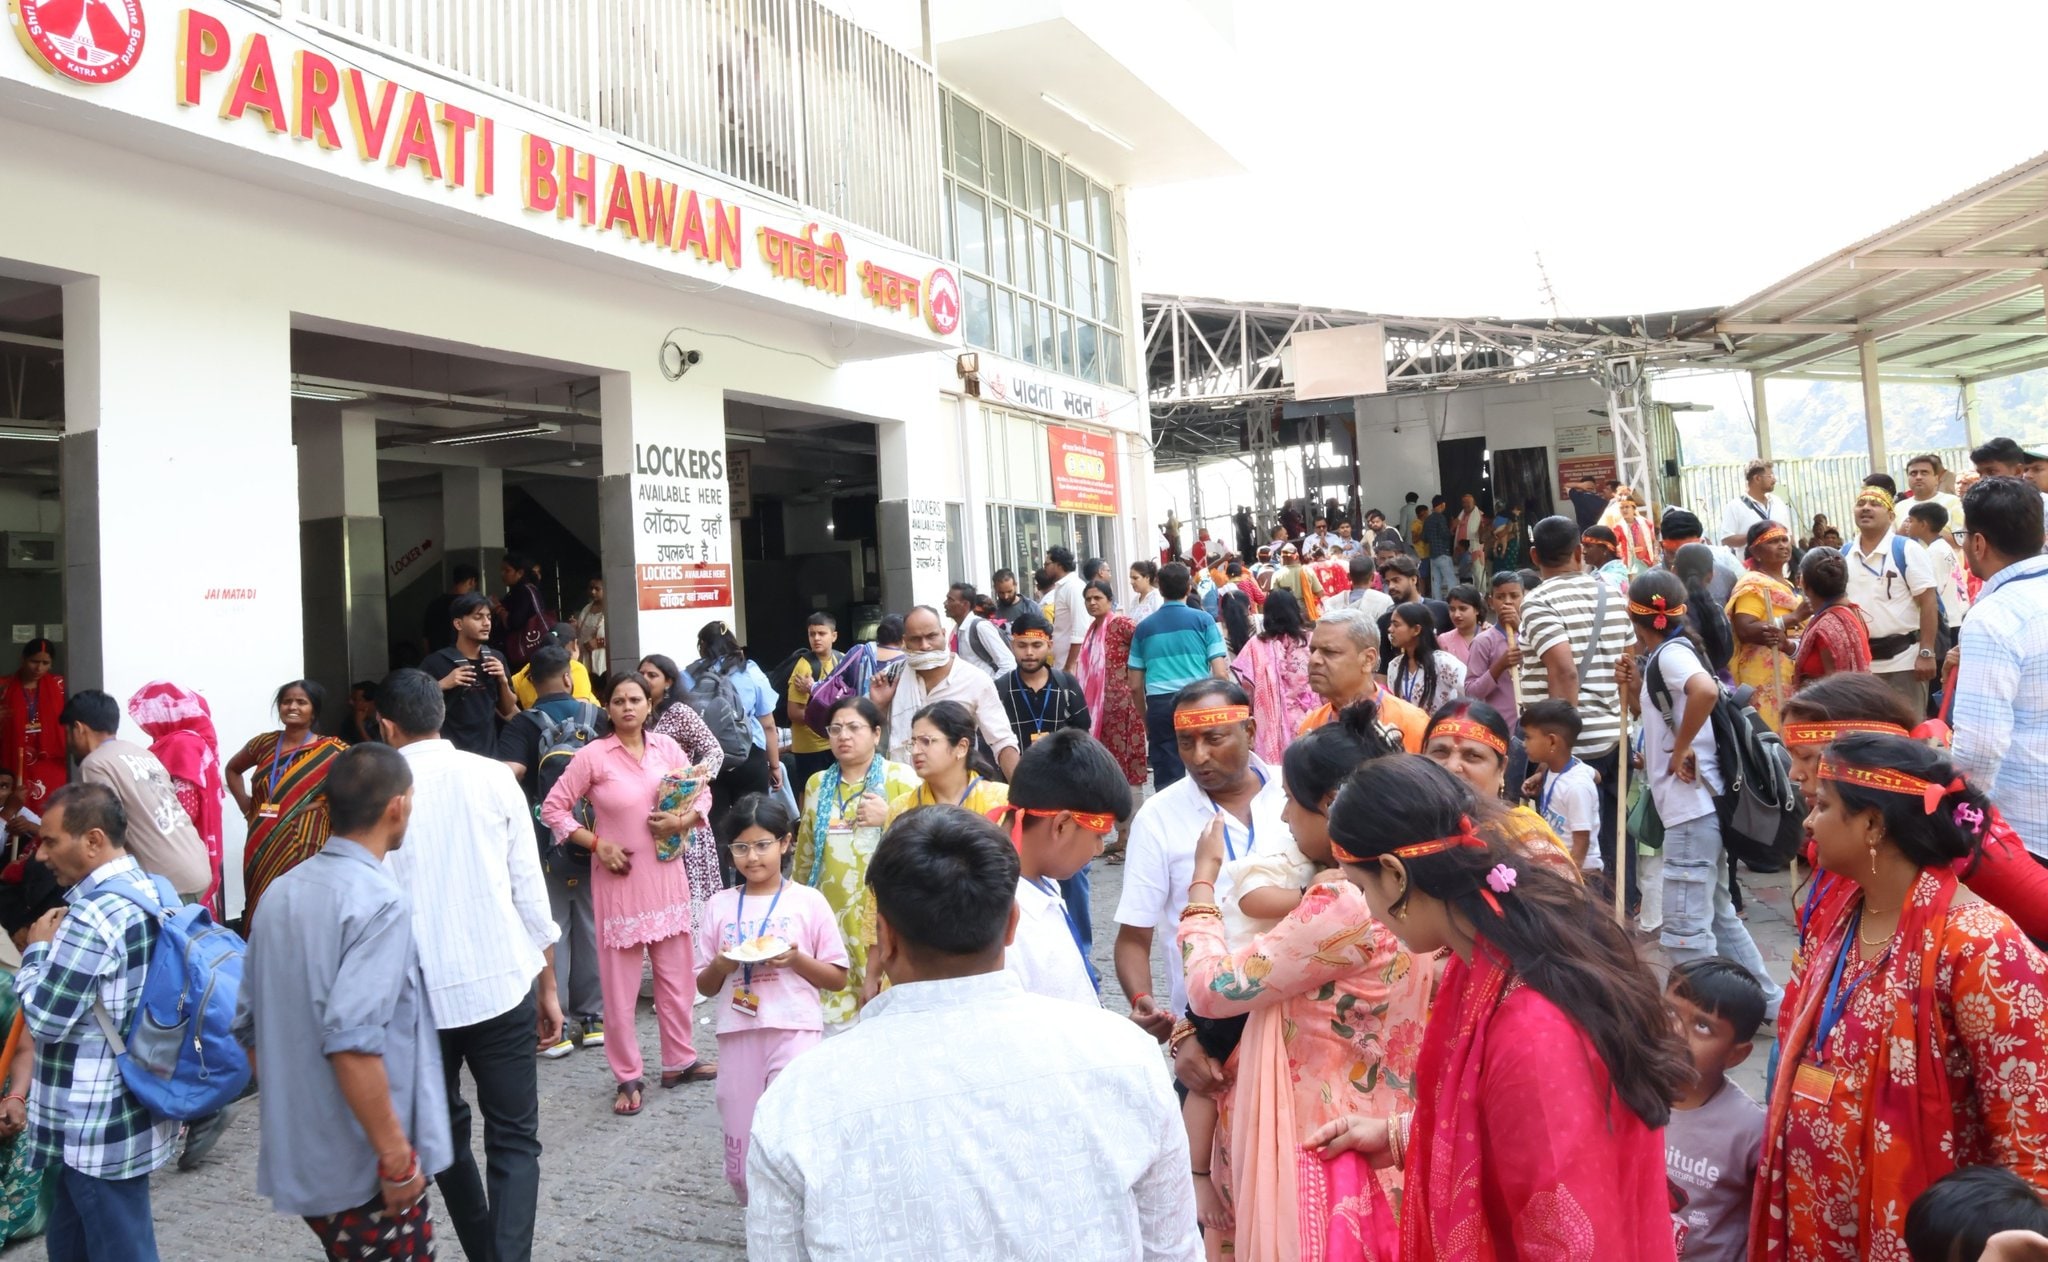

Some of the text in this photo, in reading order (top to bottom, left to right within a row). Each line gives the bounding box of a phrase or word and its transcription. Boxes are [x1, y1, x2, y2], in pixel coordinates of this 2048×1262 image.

[24, 5, 42, 35] Shri
[121, 28, 141, 66] Board
[67, 62, 97, 77] KATRA
[176, 8, 742, 270] PARVATI BHAWAN
[756, 223, 848, 296] पार्वती
[856, 259, 921, 318] भवन
[636, 443, 723, 480] LOCKERS
[639, 483, 722, 505] AVAILABLE HERE
[912, 499, 941, 516] LOCKERS
[643, 507, 691, 535] लॉकर
[391, 547, 422, 576] LOCKER
[657, 543, 694, 562] उपलब्ध
[642, 566, 726, 580] LOCKERS AVAILABLE HERE
[205, 588, 220, 600] JAI
[659, 588, 685, 607] लॉकर
[1200, 713, 1228, 723] जय
[1796, 730, 1837, 739] जय
